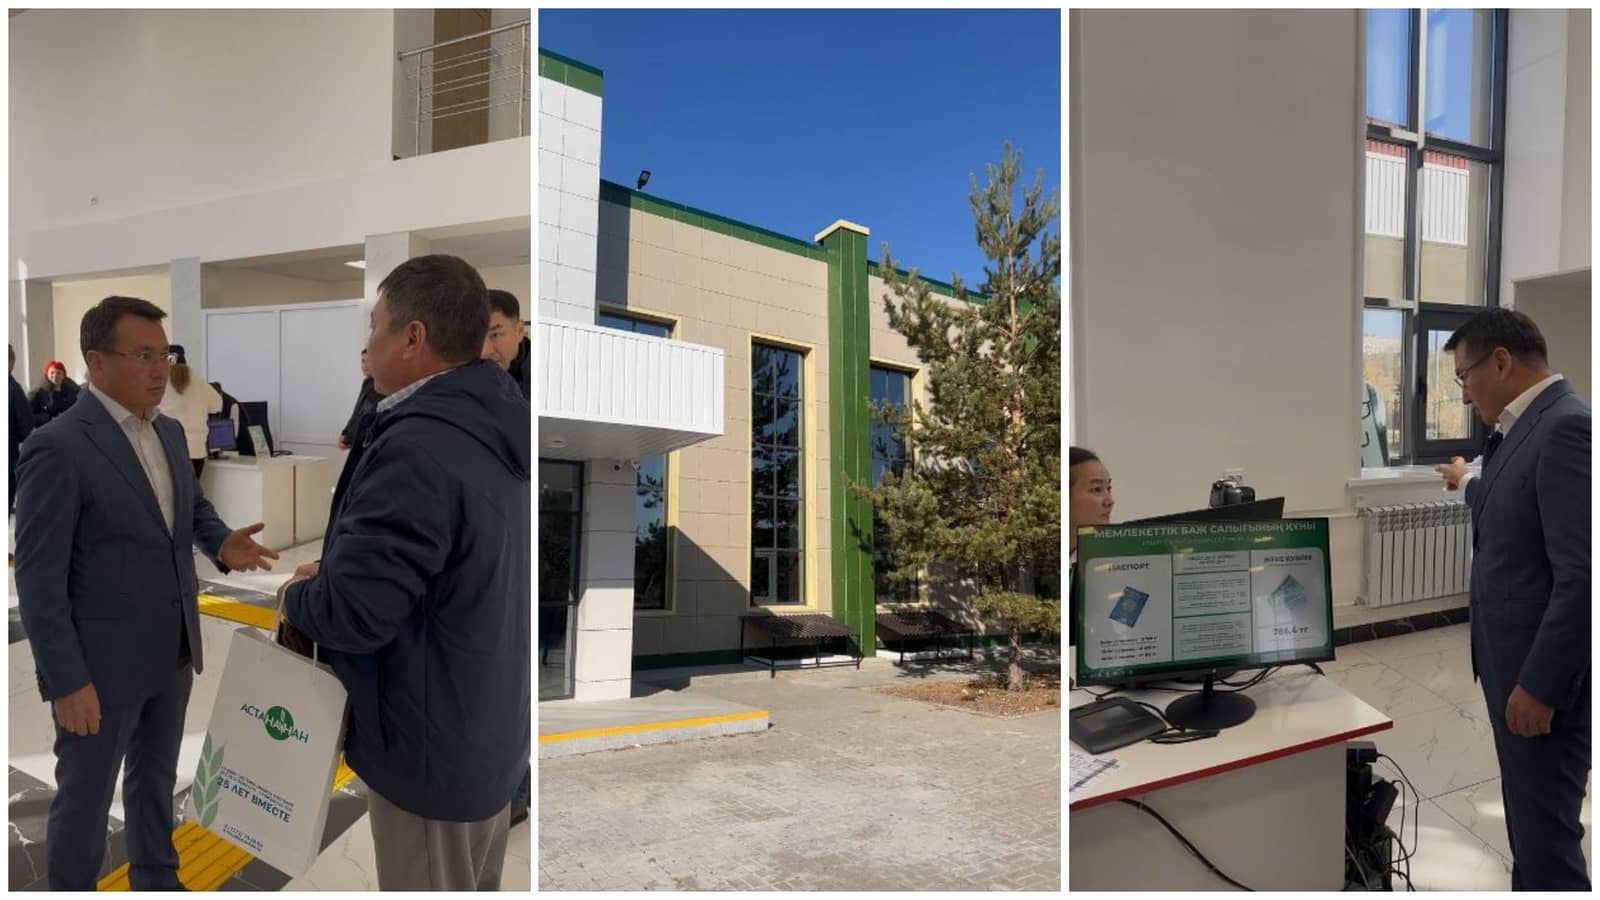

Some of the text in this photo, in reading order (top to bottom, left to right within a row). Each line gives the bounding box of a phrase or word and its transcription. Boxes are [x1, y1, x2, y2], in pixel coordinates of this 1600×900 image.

[1095, 526, 1178, 538] МЕМЛЕКЕТТІК
[1181, 524, 1207, 535] БАЖ
[217, 776, 291, 824] 25 ЛЕТ ВМЕСТЕ
